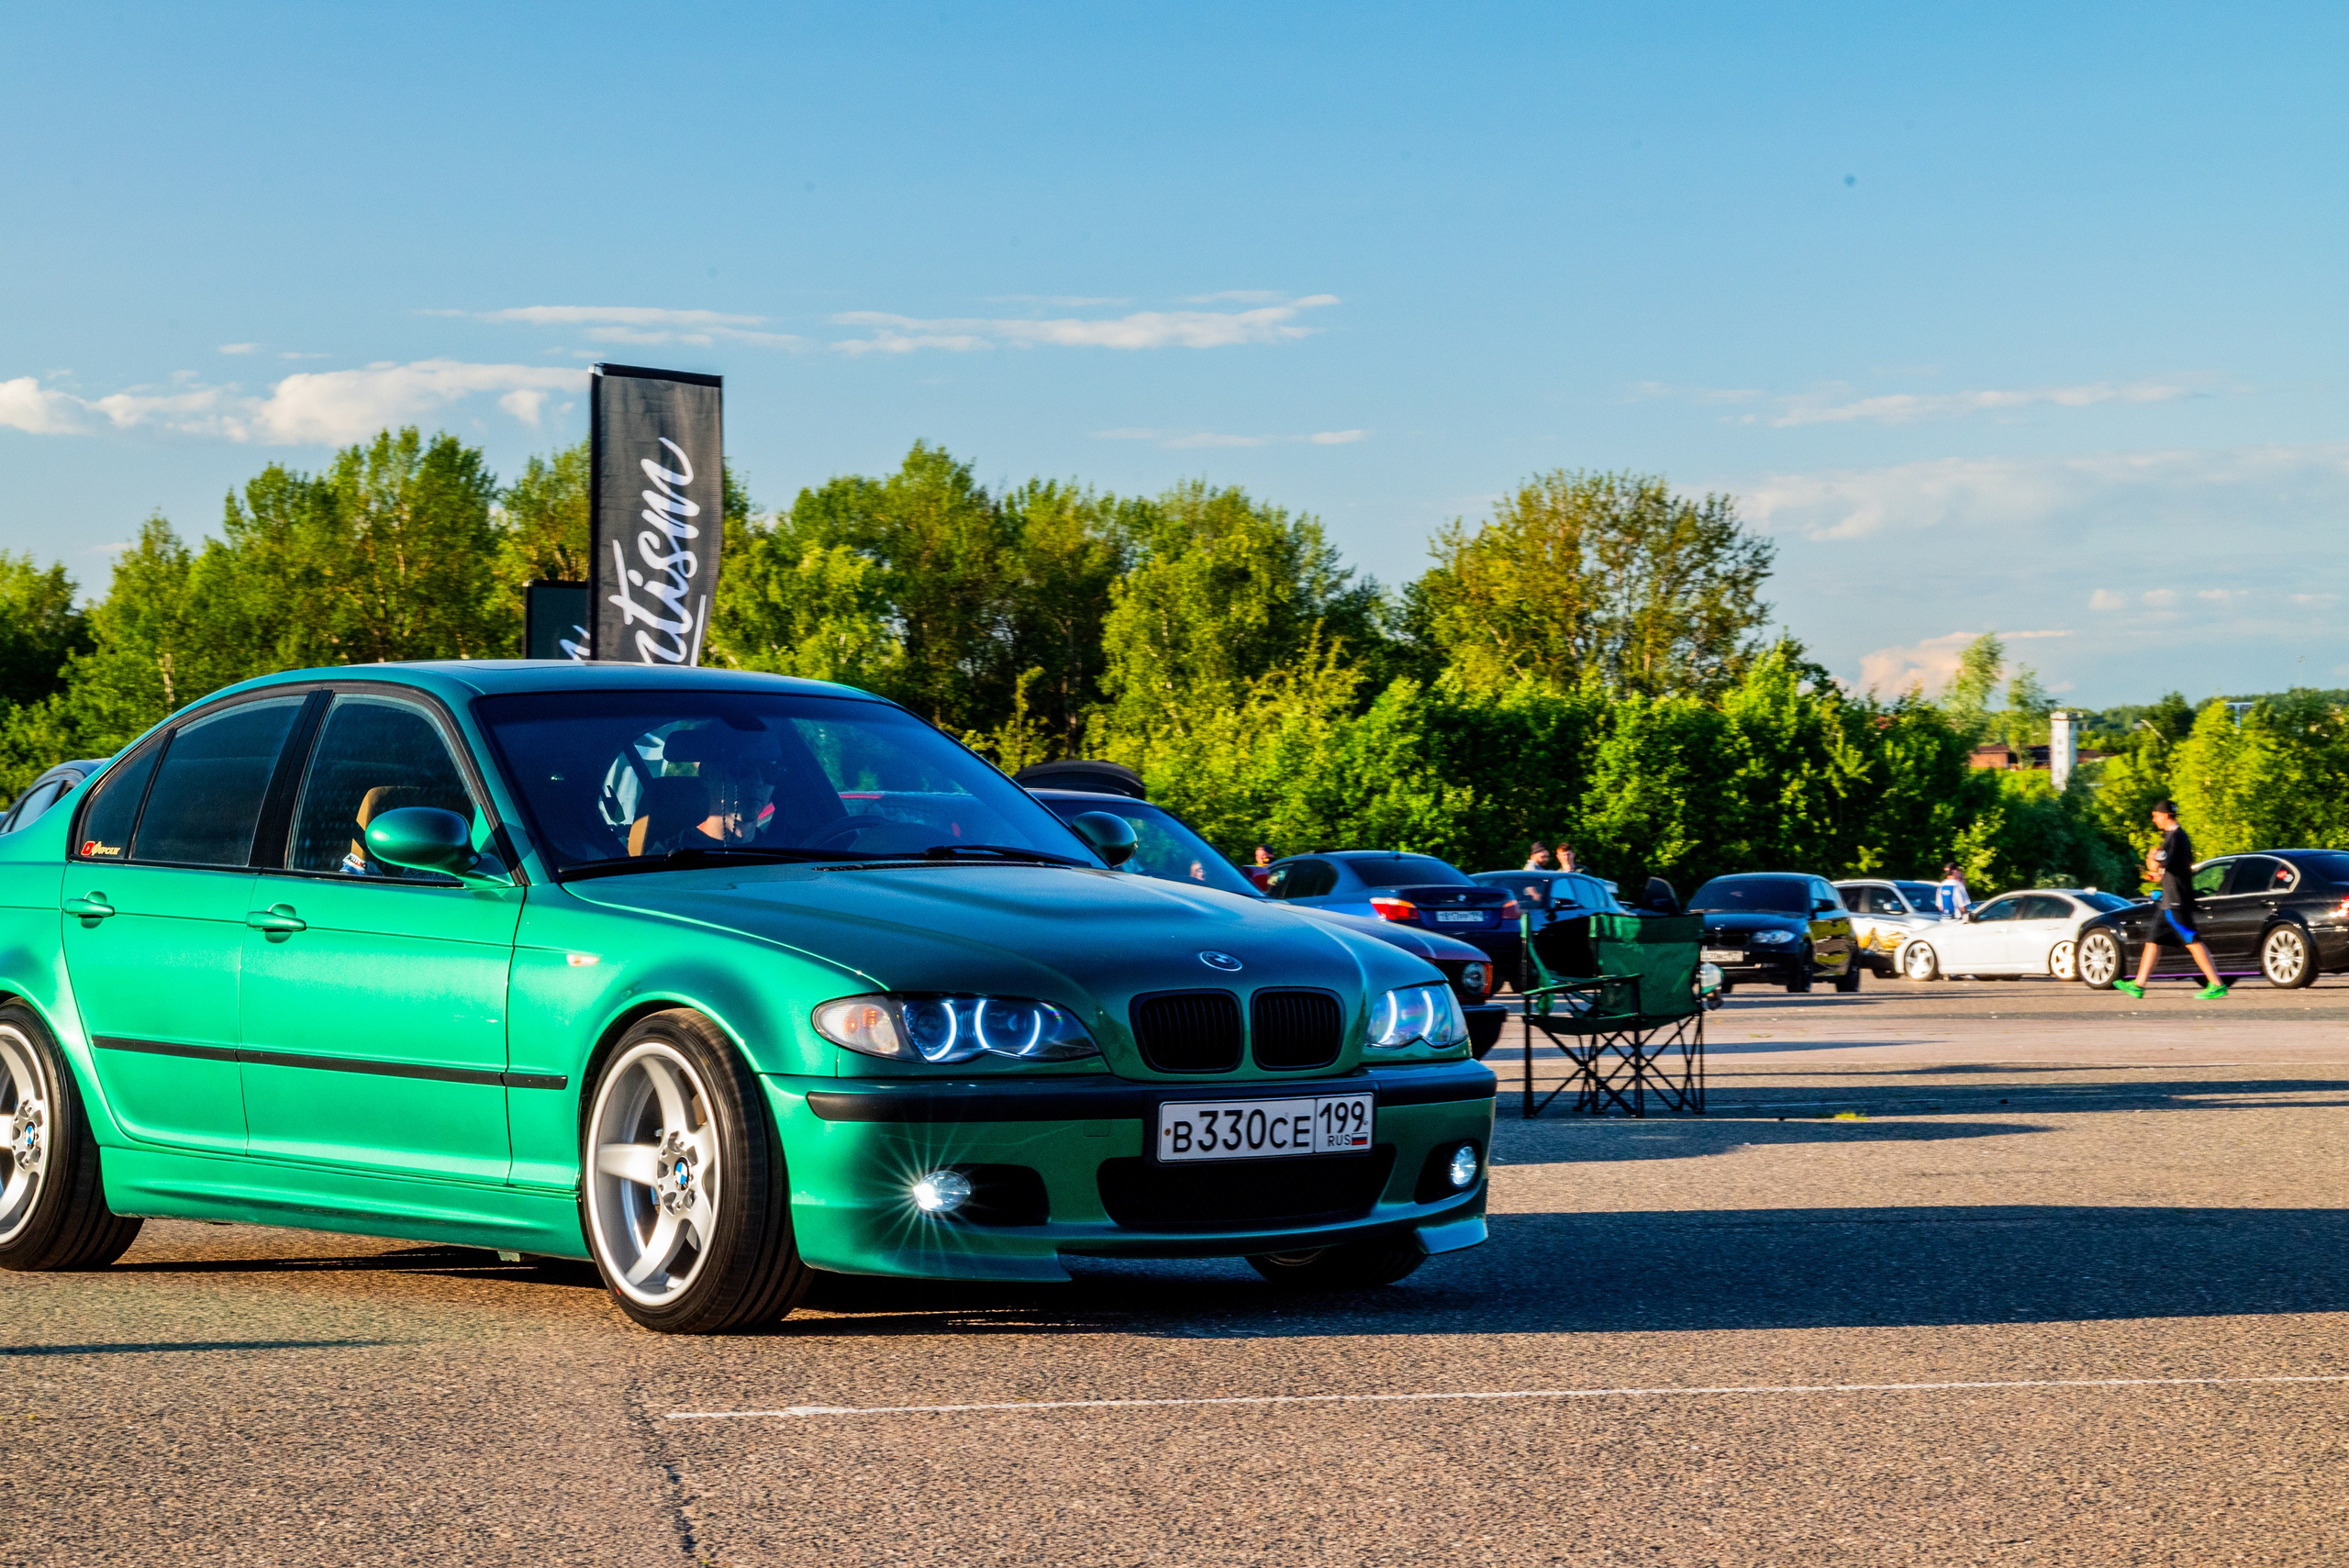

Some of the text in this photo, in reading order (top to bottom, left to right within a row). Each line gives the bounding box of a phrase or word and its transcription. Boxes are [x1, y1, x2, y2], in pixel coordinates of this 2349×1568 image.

[1173, 1101, 1365, 1153] B330CE 199
[1327, 1134, 1352, 1147] RUS
